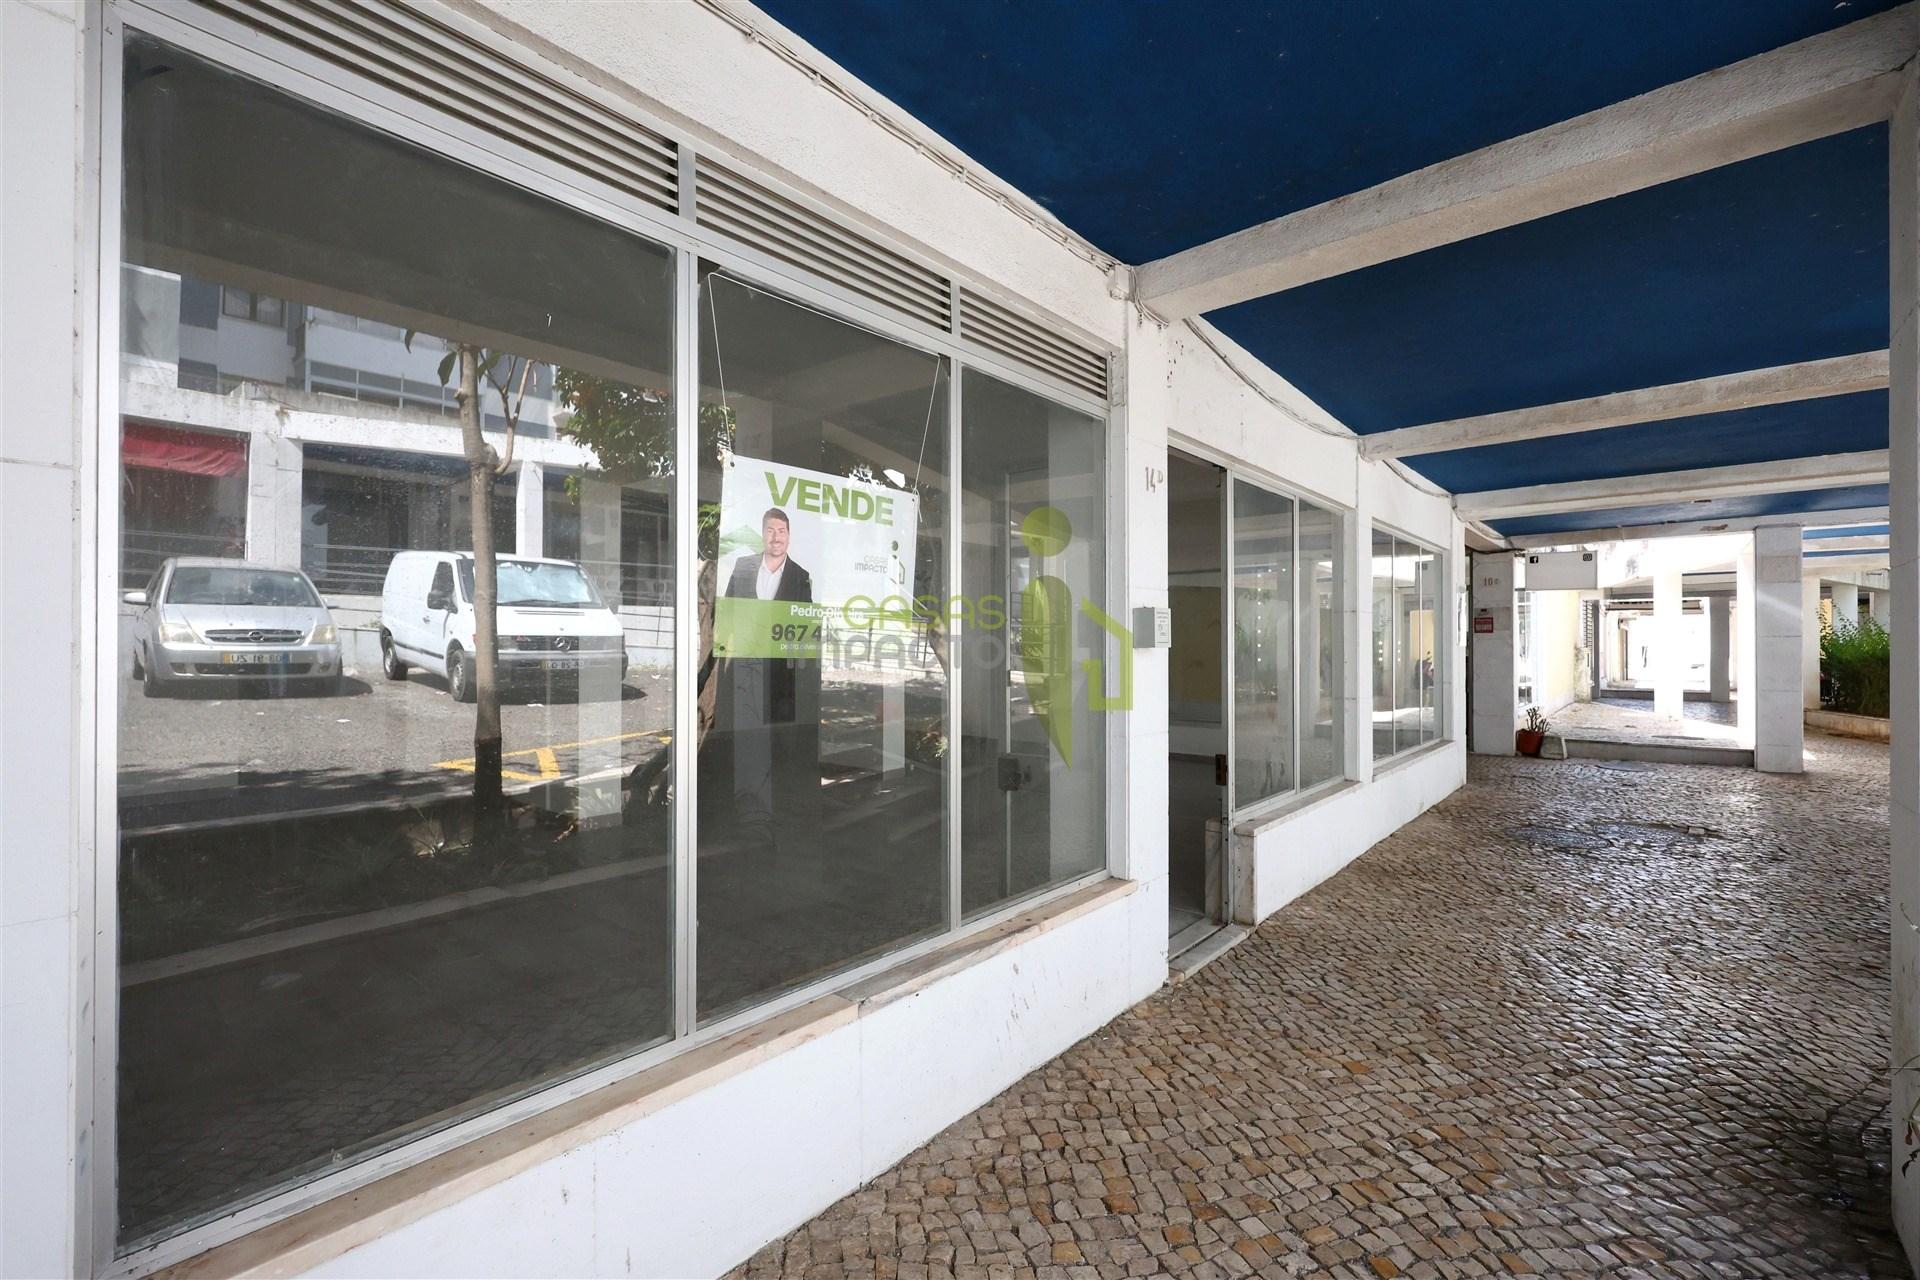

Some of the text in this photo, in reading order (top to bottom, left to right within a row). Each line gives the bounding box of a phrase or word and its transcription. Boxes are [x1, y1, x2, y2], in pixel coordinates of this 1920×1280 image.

[764, 471, 894, 526] VENDE
[790, 604, 824, 618] Pedro
[771, 623, 808, 642] 967
